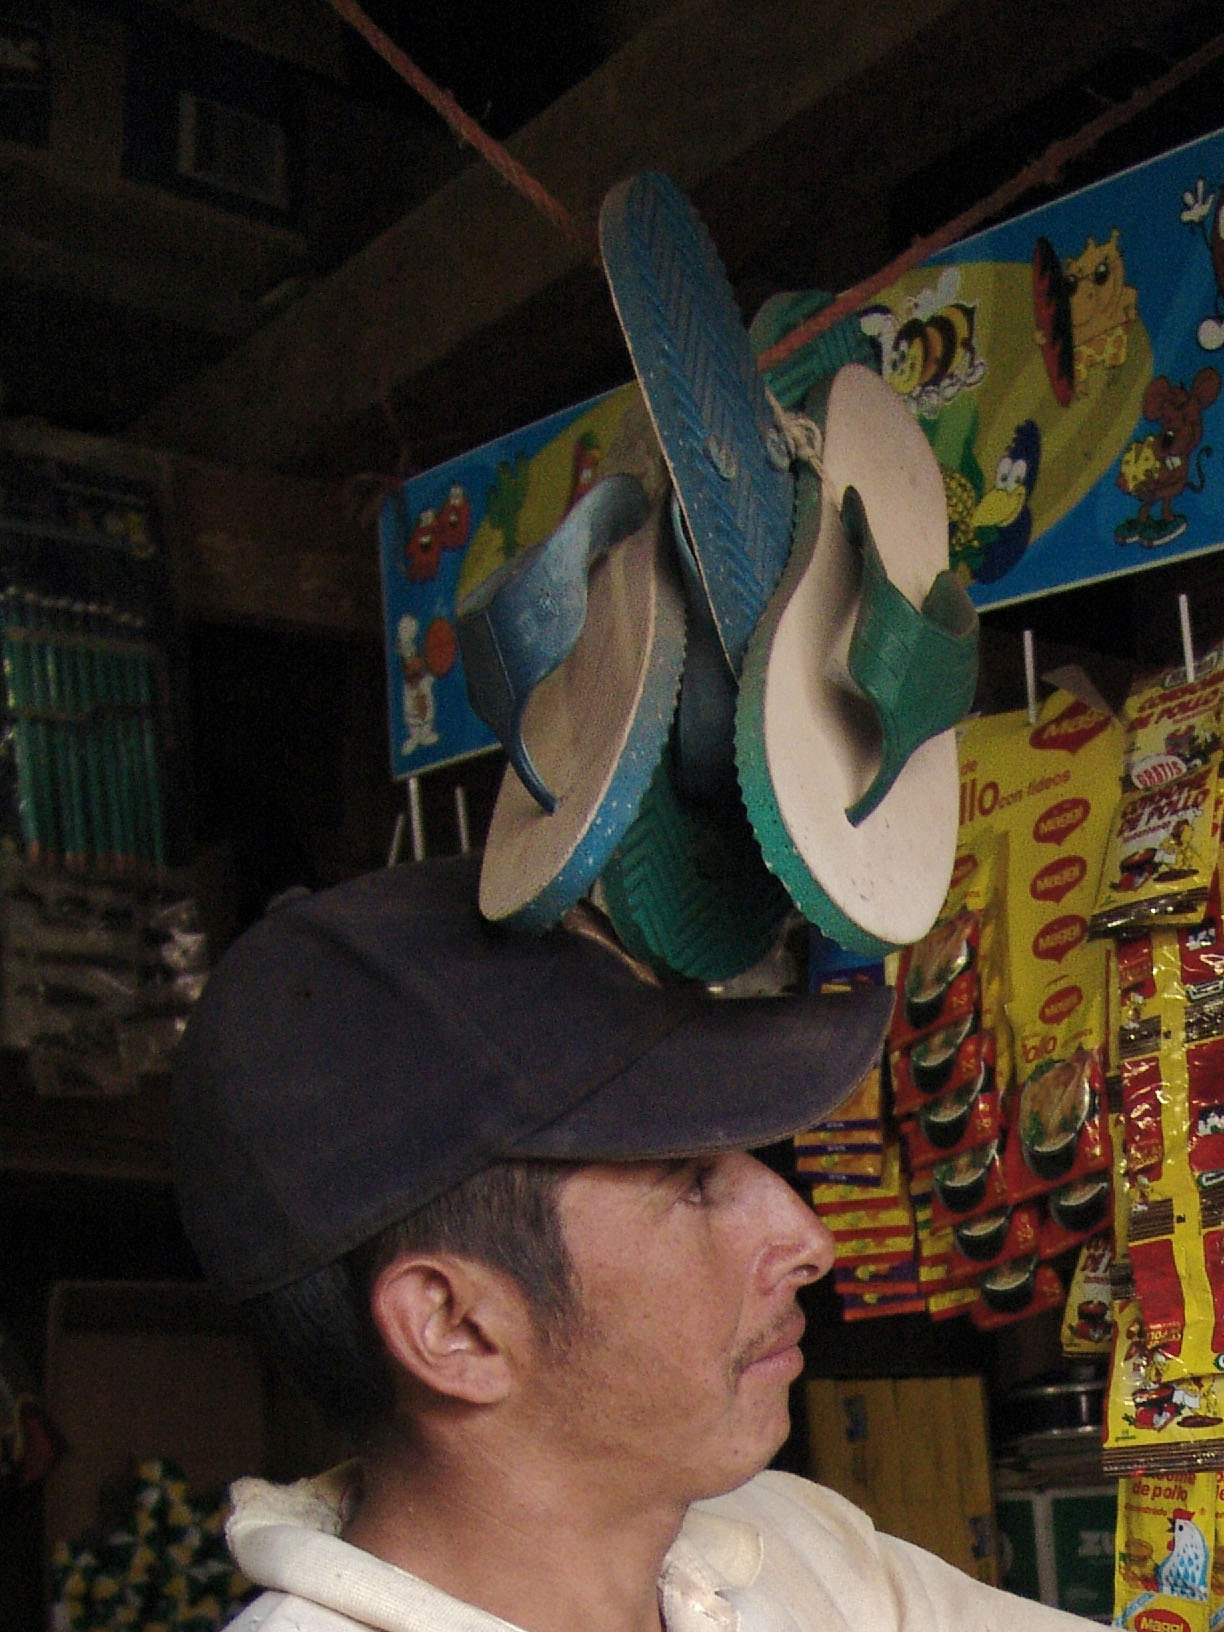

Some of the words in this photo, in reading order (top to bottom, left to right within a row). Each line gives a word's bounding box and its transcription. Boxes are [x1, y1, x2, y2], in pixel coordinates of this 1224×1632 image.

[1136, 760, 1182, 787] GRATIS
[959, 779, 1000, 825] llo
[1145, 788, 1209, 826] POLLO
[1132, 1481, 1150, 1496] de
[1151, 1485, 1188, 1502] pollo
